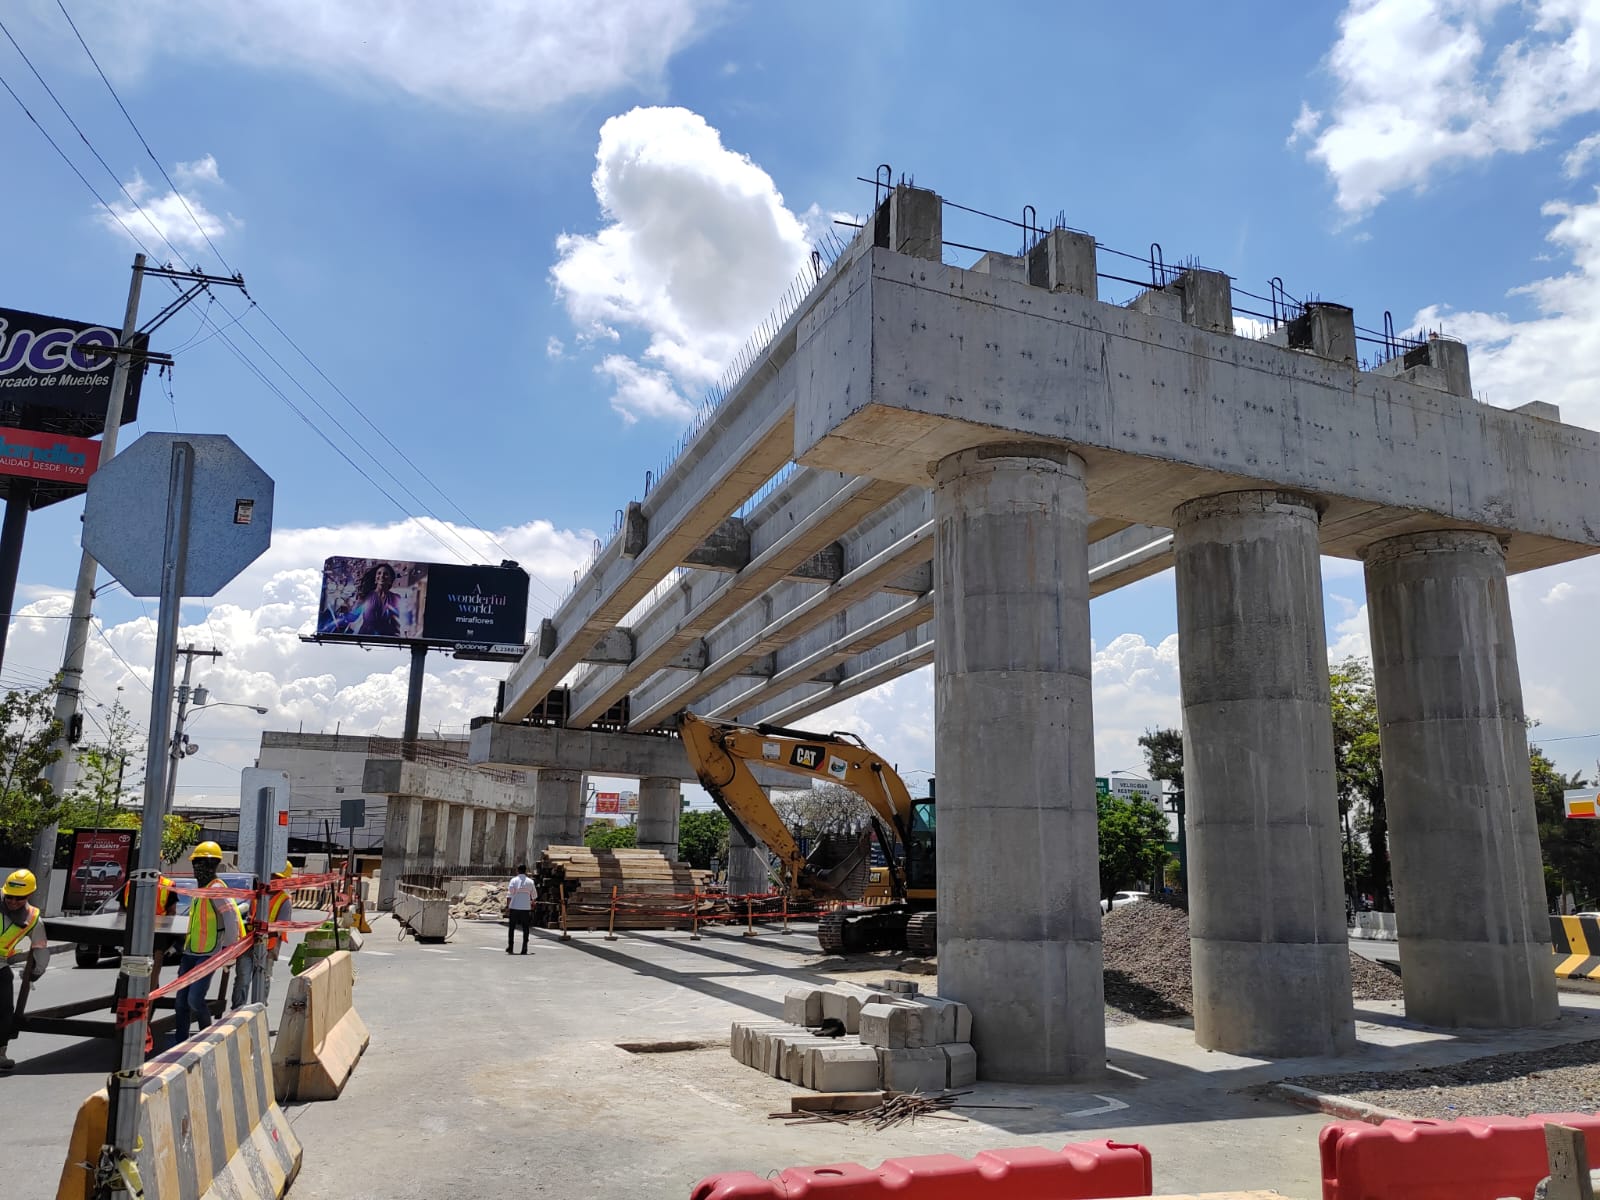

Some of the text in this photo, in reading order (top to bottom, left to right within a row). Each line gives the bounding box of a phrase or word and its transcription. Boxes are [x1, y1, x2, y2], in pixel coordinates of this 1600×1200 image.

[40, 374, 56, 387] de
[58, 373, 110, 387] Muebles
[33, 461, 61, 472] DESDE
[65, 466, 85, 475] 1973
[472, 583, 482, 595] A
[456, 616, 493, 625] miraflores
[796, 747, 817, 767] CAT
[869, 872, 880, 882] CAT
